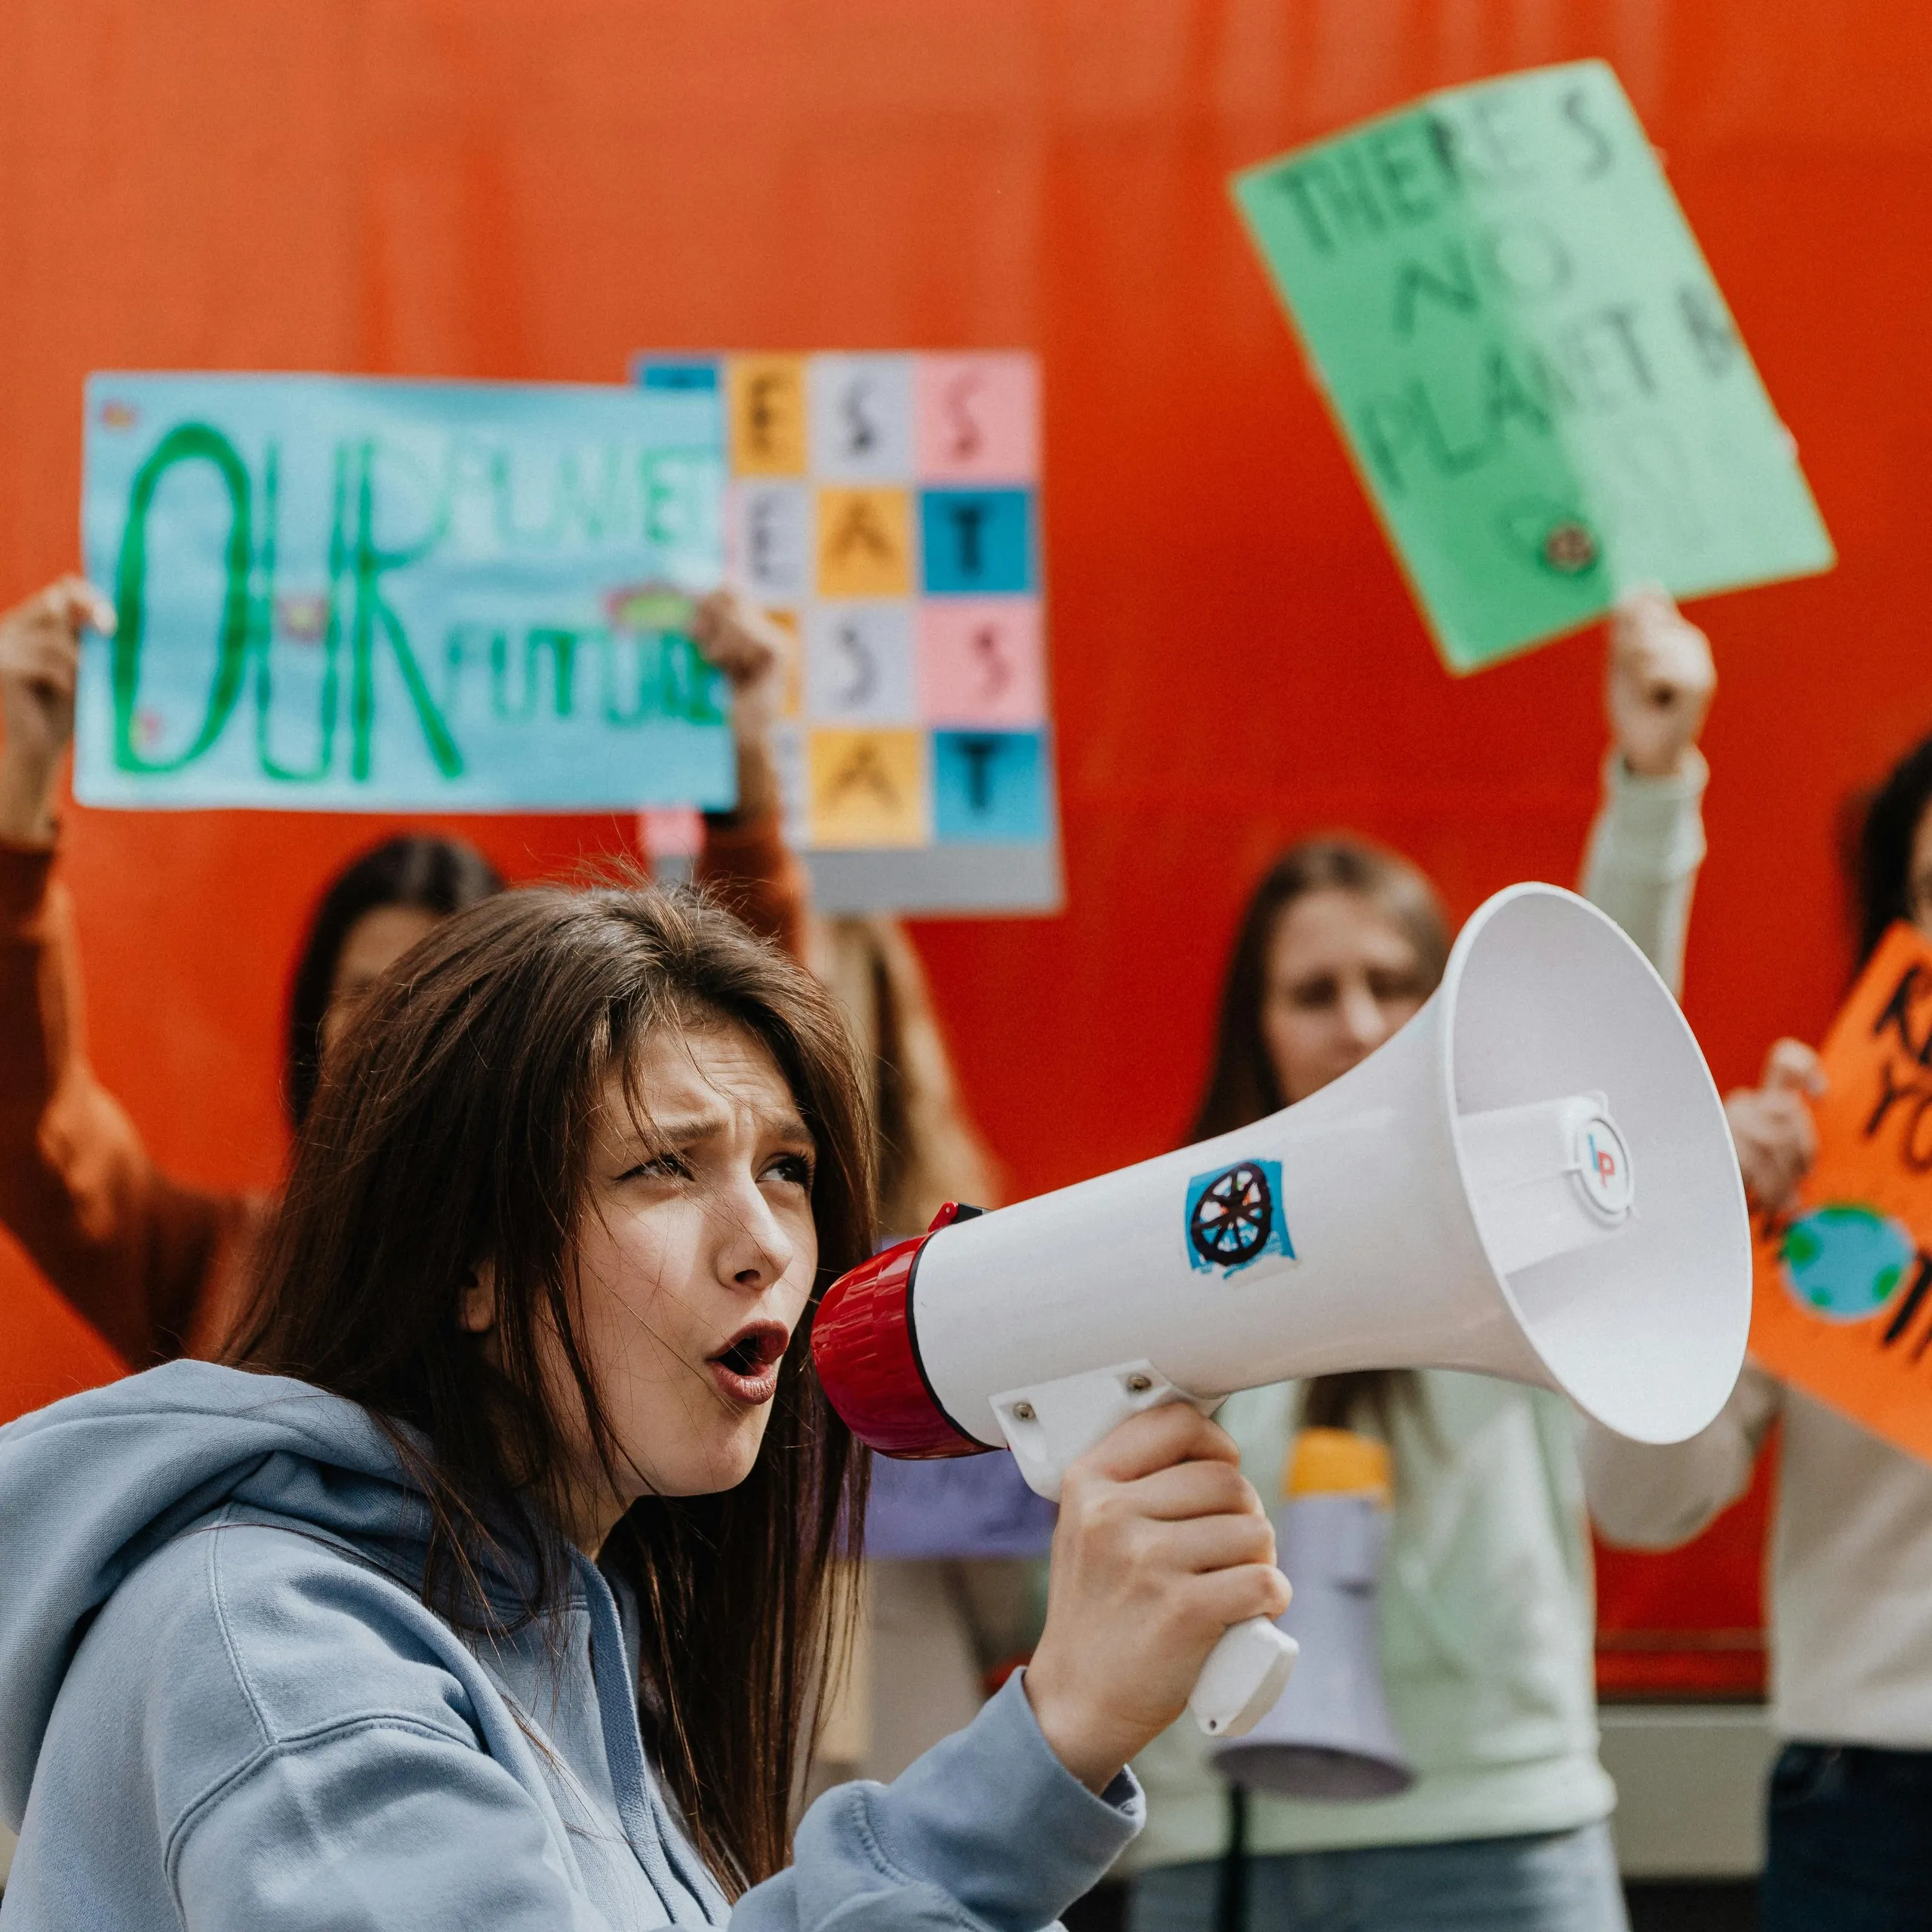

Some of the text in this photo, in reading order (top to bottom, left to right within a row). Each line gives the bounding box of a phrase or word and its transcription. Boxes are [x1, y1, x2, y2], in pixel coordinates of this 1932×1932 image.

[1391, 217, 1574, 343] NO
[672, 369, 986, 461] ESS
[743, 491, 998, 580] EAT
[112, 420, 466, 785] OUR
